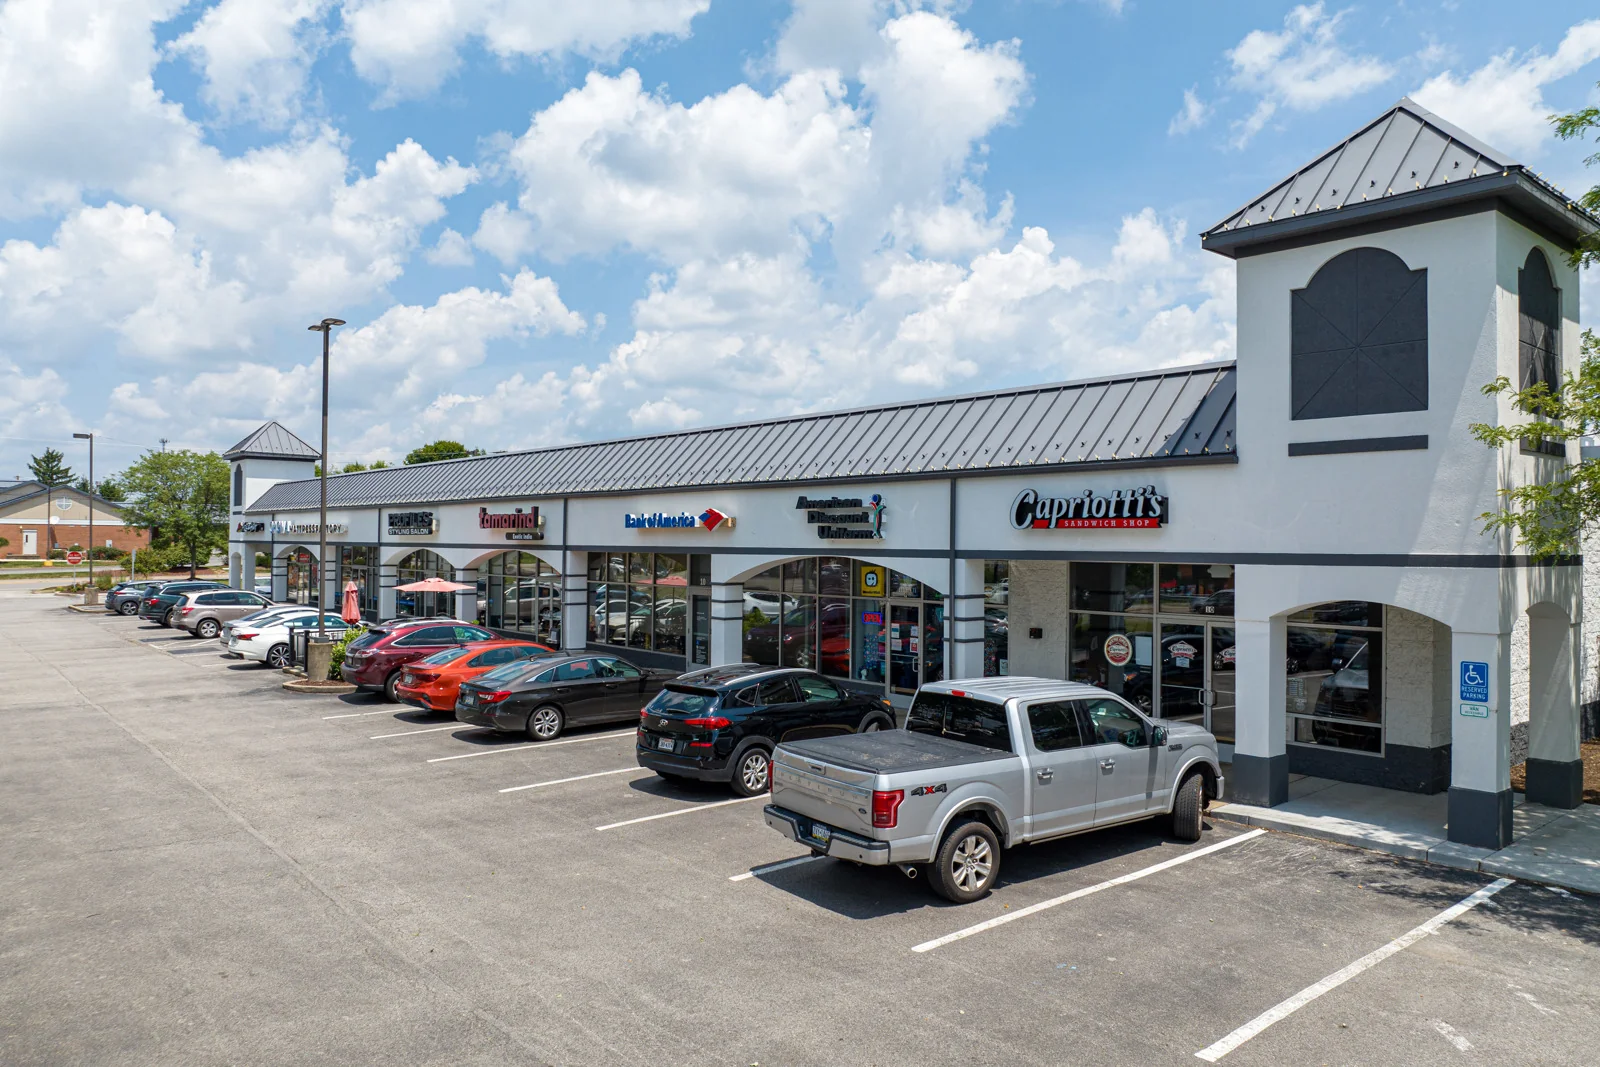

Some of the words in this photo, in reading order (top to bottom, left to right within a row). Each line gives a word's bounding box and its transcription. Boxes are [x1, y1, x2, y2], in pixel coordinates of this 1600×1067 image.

[796, 496, 863, 509] American
[1010, 485, 1165, 530] Capriotti's
[388, 512, 433, 526] PROFILES
[479, 506, 539, 528] tamarind
[624, 513, 646, 528] Bank
[646, 512, 657, 528] of
[657, 512, 696, 528] America
[808, 511, 870, 524] Discount
[316, 524, 342, 534] FATORY
